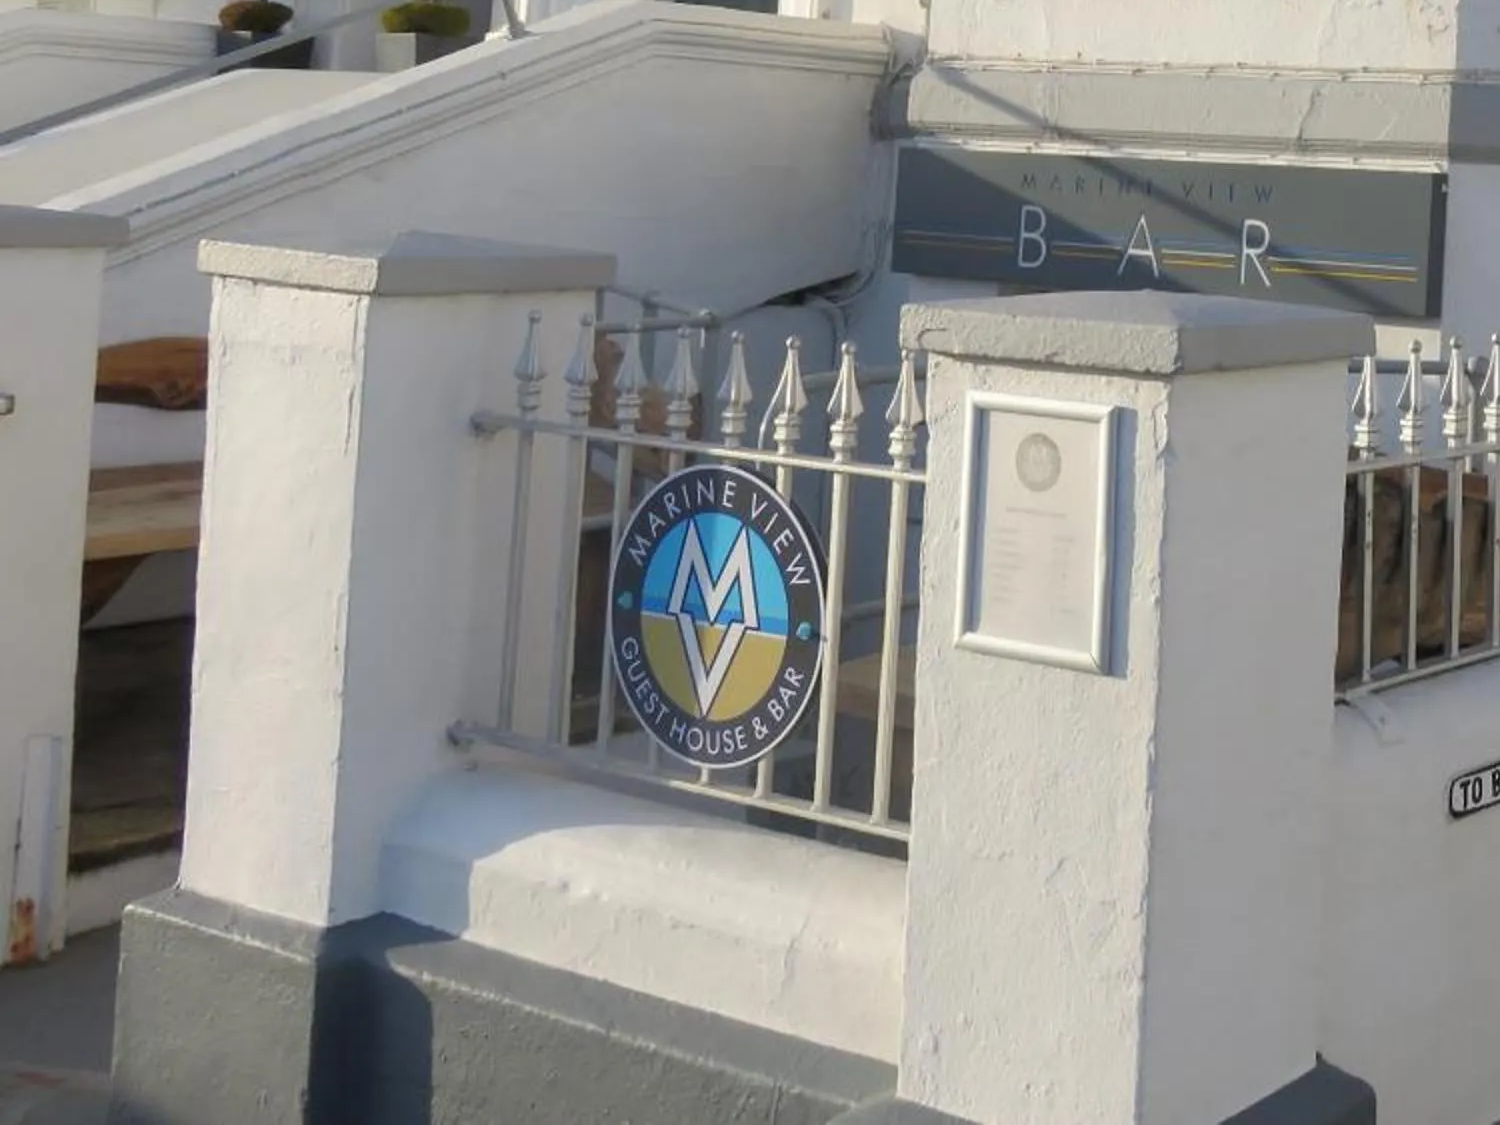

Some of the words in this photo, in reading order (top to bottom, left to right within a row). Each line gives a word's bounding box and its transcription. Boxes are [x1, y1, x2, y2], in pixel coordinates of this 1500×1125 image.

[1017, 205, 1272, 287] BAR
[628, 480, 737, 566] MARINE
[750, 493, 811, 586] VIEW
[621, 637, 669, 726] GUEST
[669, 721, 748, 755] HOUSE
[752, 719, 769, 740] &
[767, 666, 805, 723] BAR
[1460, 777, 1483, 809] TO
